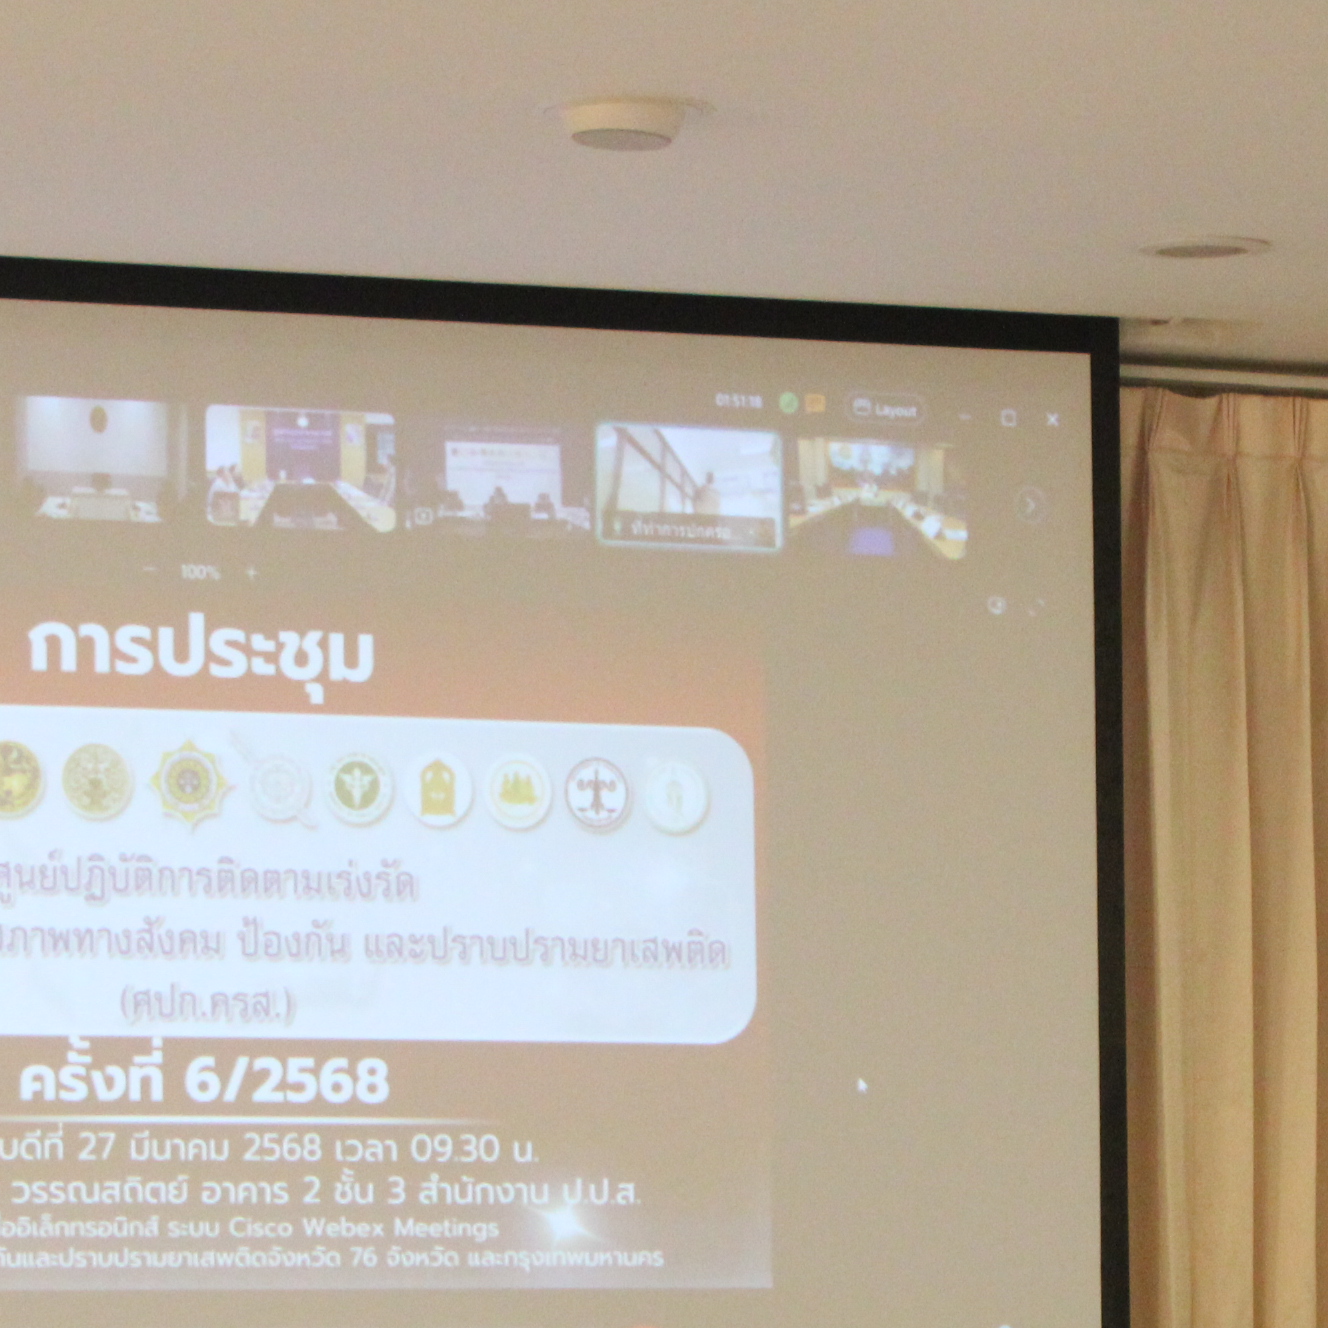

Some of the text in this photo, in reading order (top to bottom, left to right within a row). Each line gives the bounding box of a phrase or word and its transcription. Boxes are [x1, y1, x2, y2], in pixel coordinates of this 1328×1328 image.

[876, 402, 918, 420] Layout
[28, 611, 373, 704] การประชุม
[238, 915, 349, 962] ป้องกัน
[364, 926, 729, 968] และปราบปรามยาเสพติด
[20, 1034, 389, 1104] ครั้งที่ 6/2568
[78, 1132, 115, 1161] 27
[130, 1130, 229, 1161] มีนาคม
[244, 1133, 321, 1162] 2568
[336, 1138, 398, 1162] เวลา
[410, 1134, 500, 1163] 09.30
[513, 1139, 539, 1163] น.
[11, 1174, 188, 1204] วรรณสถิตย์
[200, 1180, 289, 1204] อาคาร
[302, 1175, 321, 1204] 2
[334, 1168, 373, 1205] ชั้น
[388, 1176, 406, 1204] 3
[419, 1173, 549, 1205] สำนักงาน
[562, 1178, 641, 1205] ป.ป.ส.
[168, 1220, 220, 1238] ระบบ
[229, 1217, 292, 1238] Cisco
[304, 1217, 384, 1238] Webex
[394, 1217, 499, 1242] Meetings
[350, 1247, 377, 1267] 76
[387, 1245, 459, 1267] จังหวัด
[468, 1248, 664, 1272] และกรุงเทพมหานคร
